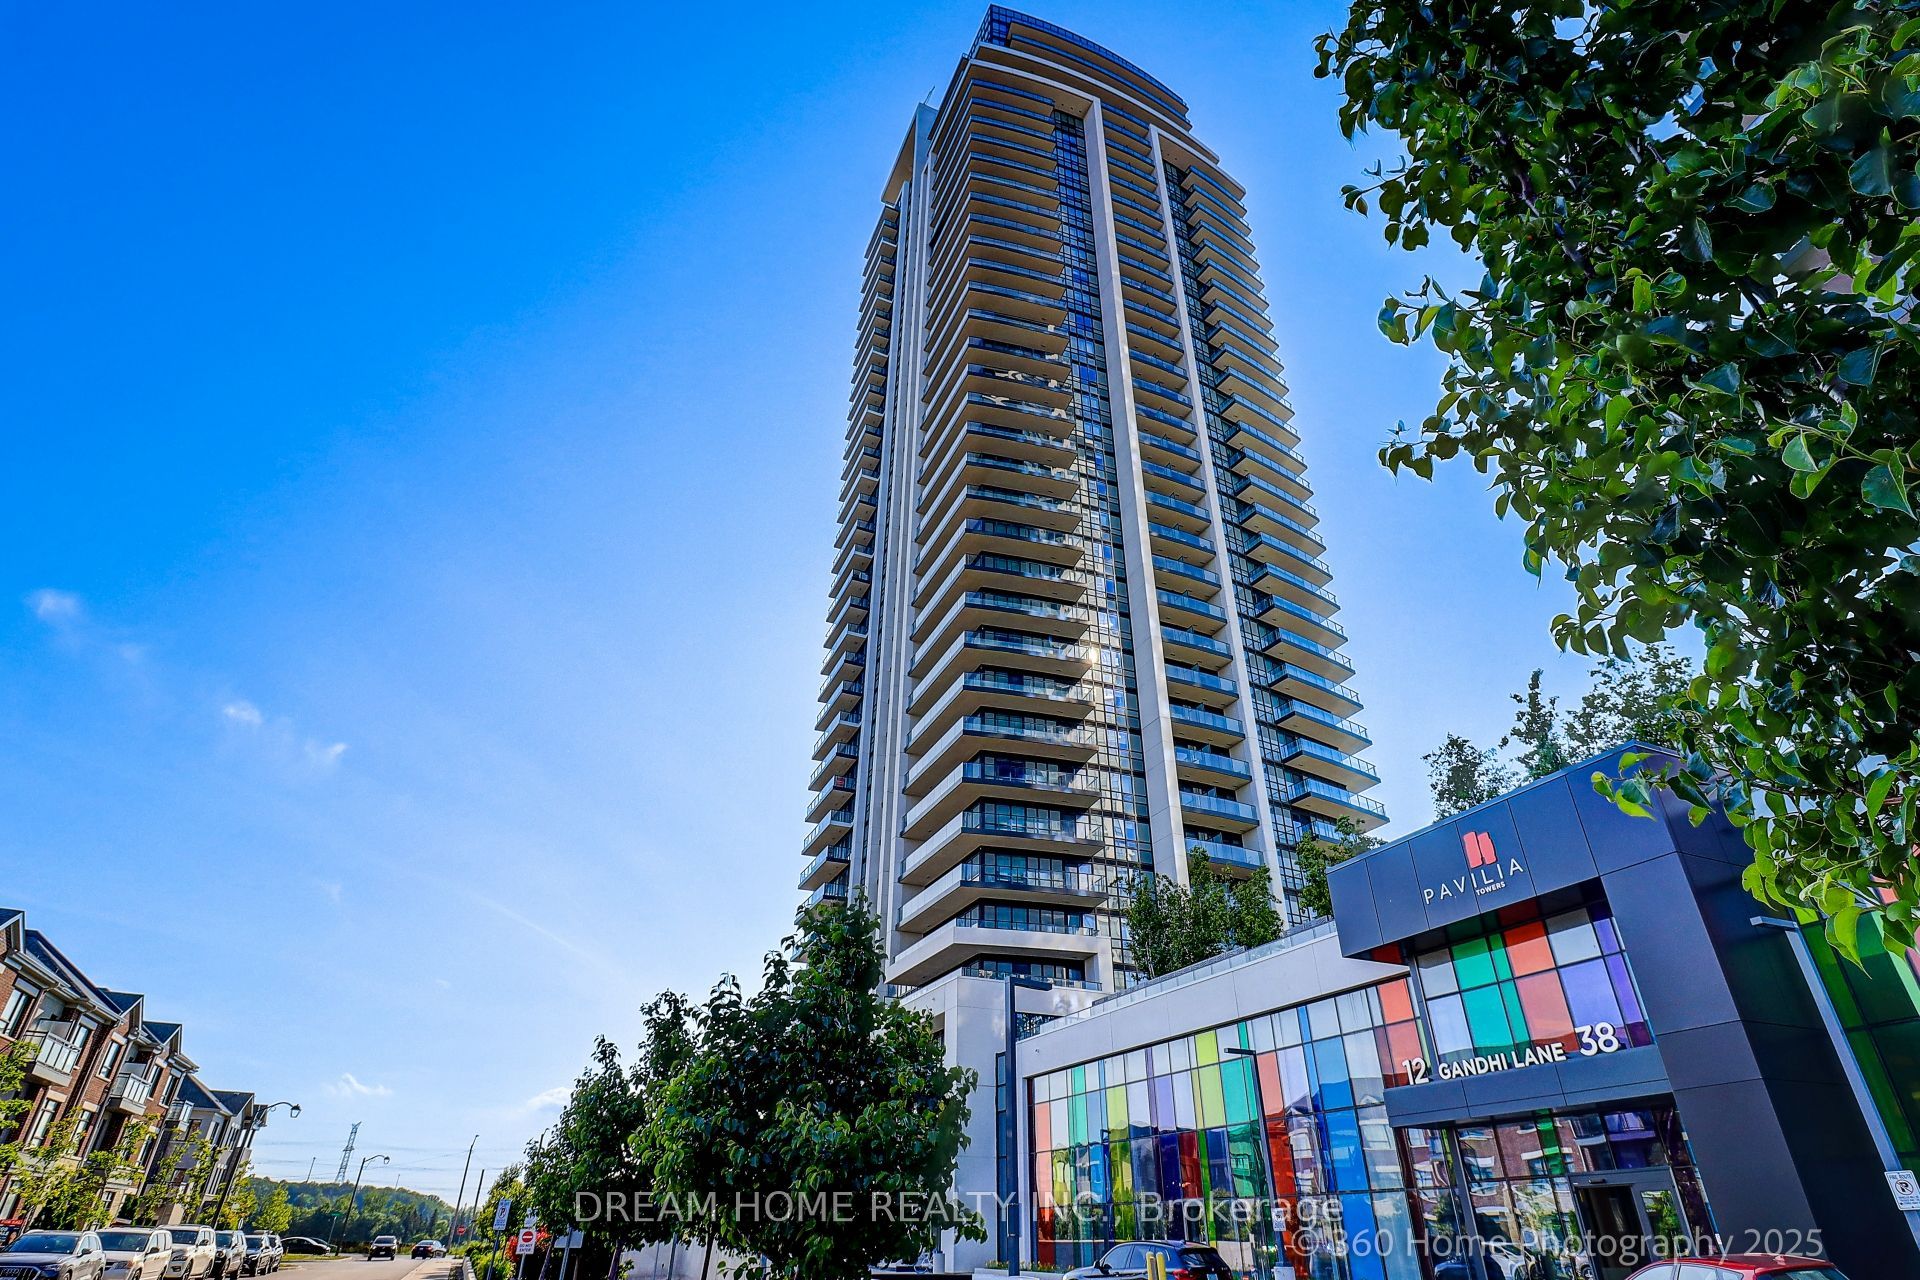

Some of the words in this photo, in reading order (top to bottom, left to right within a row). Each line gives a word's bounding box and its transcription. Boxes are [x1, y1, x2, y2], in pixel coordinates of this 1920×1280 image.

[1423, 858, 1523, 905] PAVILIA
[1476, 881, 1506, 896] TOWERS
[1402, 1057, 1429, 1085] 12
[1438, 1053, 1508, 1080] GANDHI
[1512, 1042, 1567, 1069] LANE
[1574, 1022, 1619, 1056] 38
